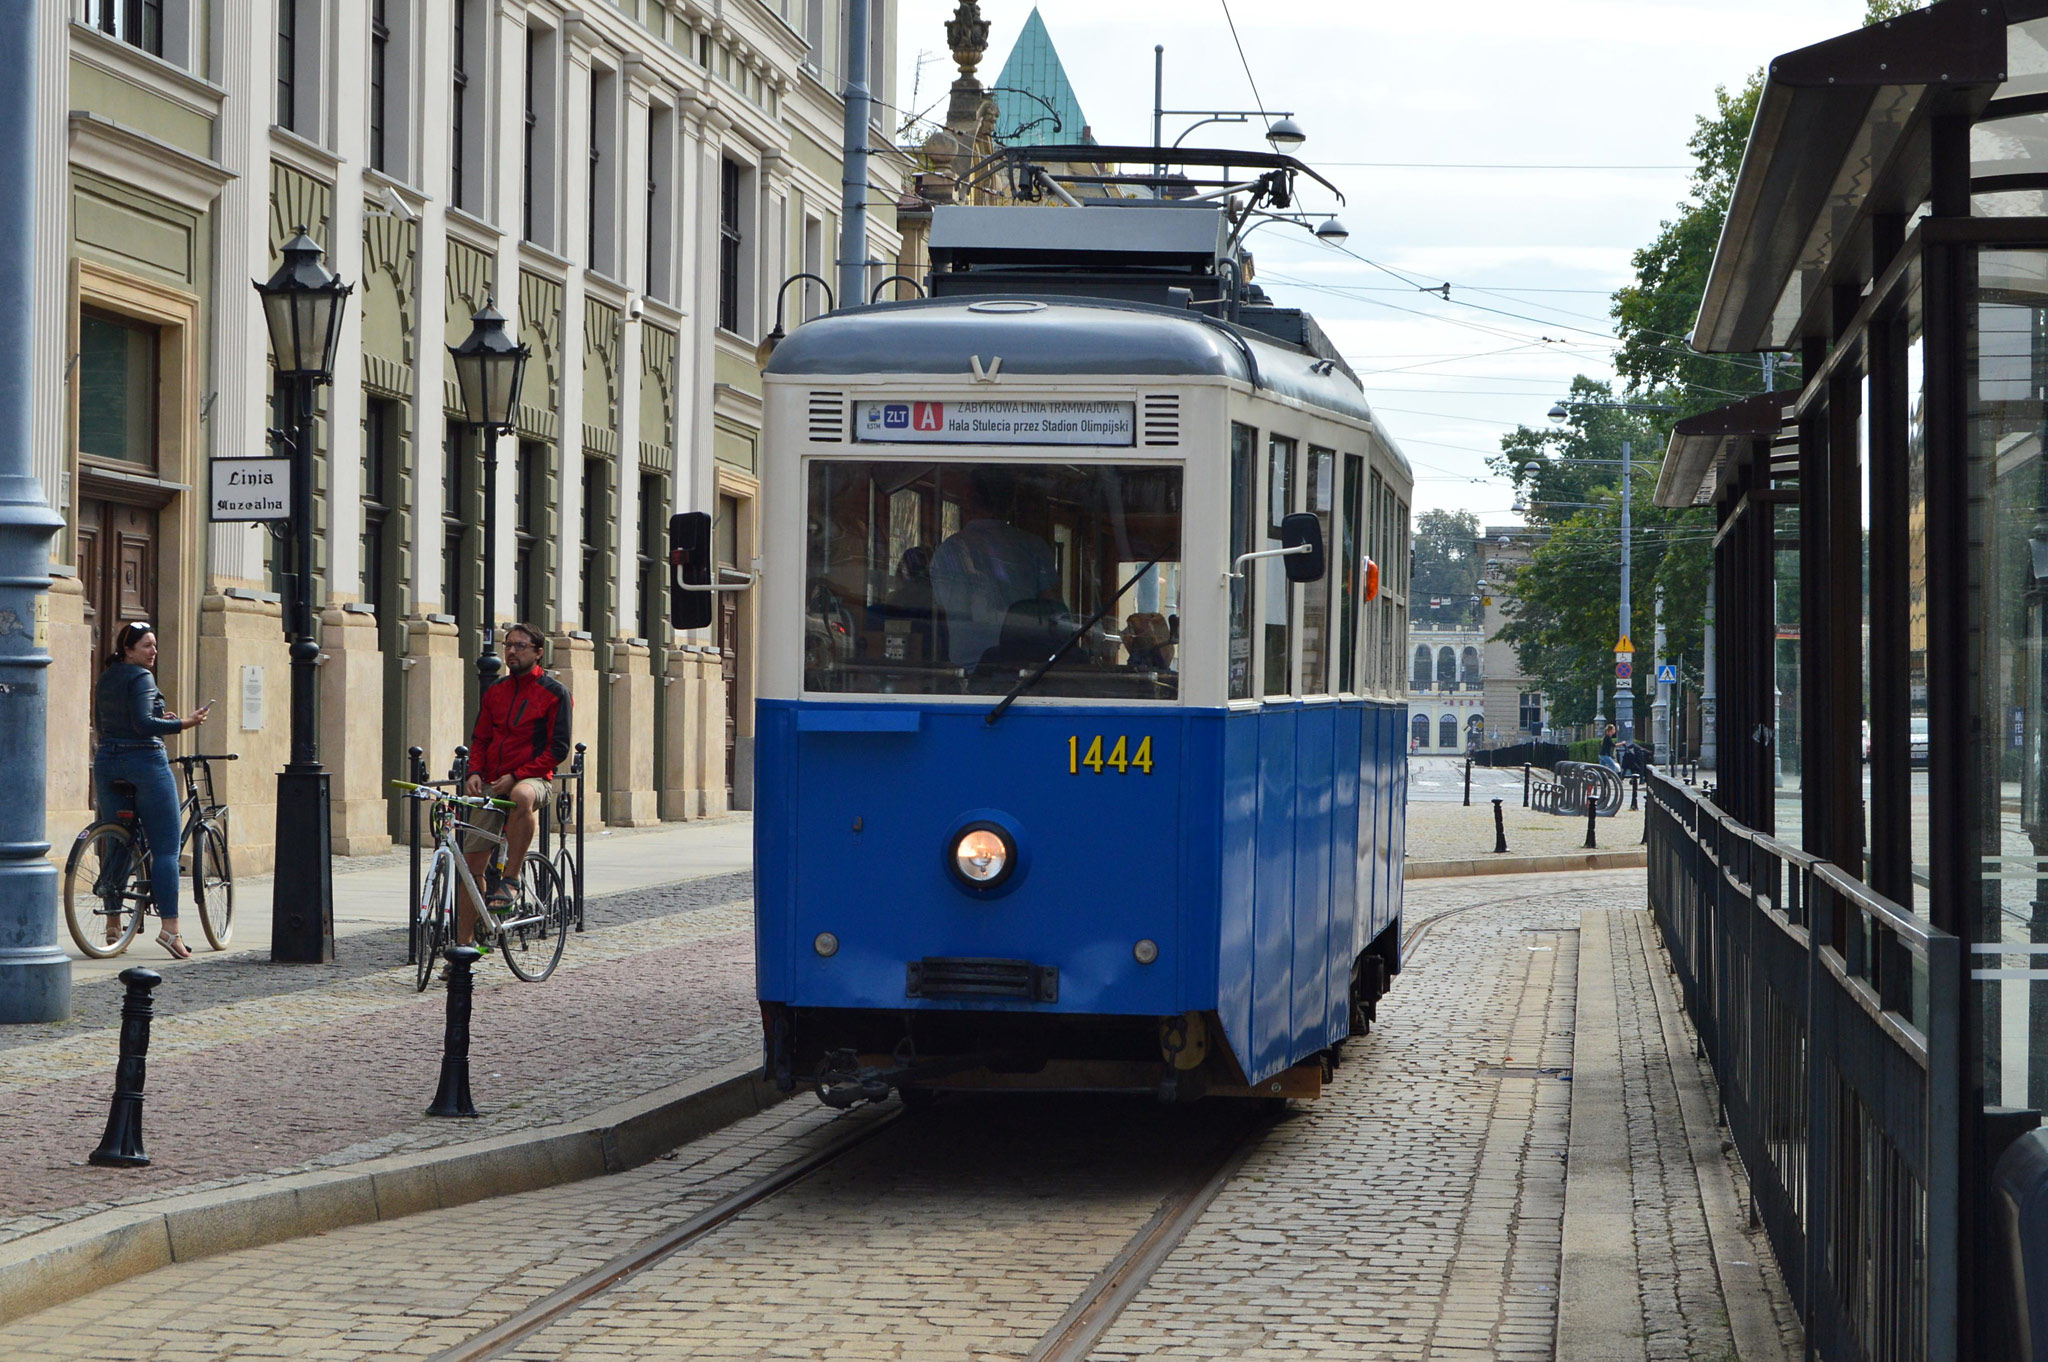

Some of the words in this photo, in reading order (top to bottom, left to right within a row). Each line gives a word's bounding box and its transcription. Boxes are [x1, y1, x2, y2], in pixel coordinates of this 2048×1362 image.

[958, 401, 1019, 413] ZABYTKOWA
[1021, 402, 1047, 413] LINIA
[1049, 402, 1120, 413] TRAMWAJOWA
[886, 411, 907, 423] ZLT
[921, 402, 936, 429] A
[949, 420, 970, 431] Hala
[972, 420, 1011, 432] Stulecia
[1013, 421, 1040, 434] przez
[1042, 420, 1078, 432] Stadion
[1081, 420, 1129, 435] Olimpijski
[228, 469, 273, 486] Linia
[217, 497, 283, 511] Muzealna
[1068, 735, 1154, 775] 1444
